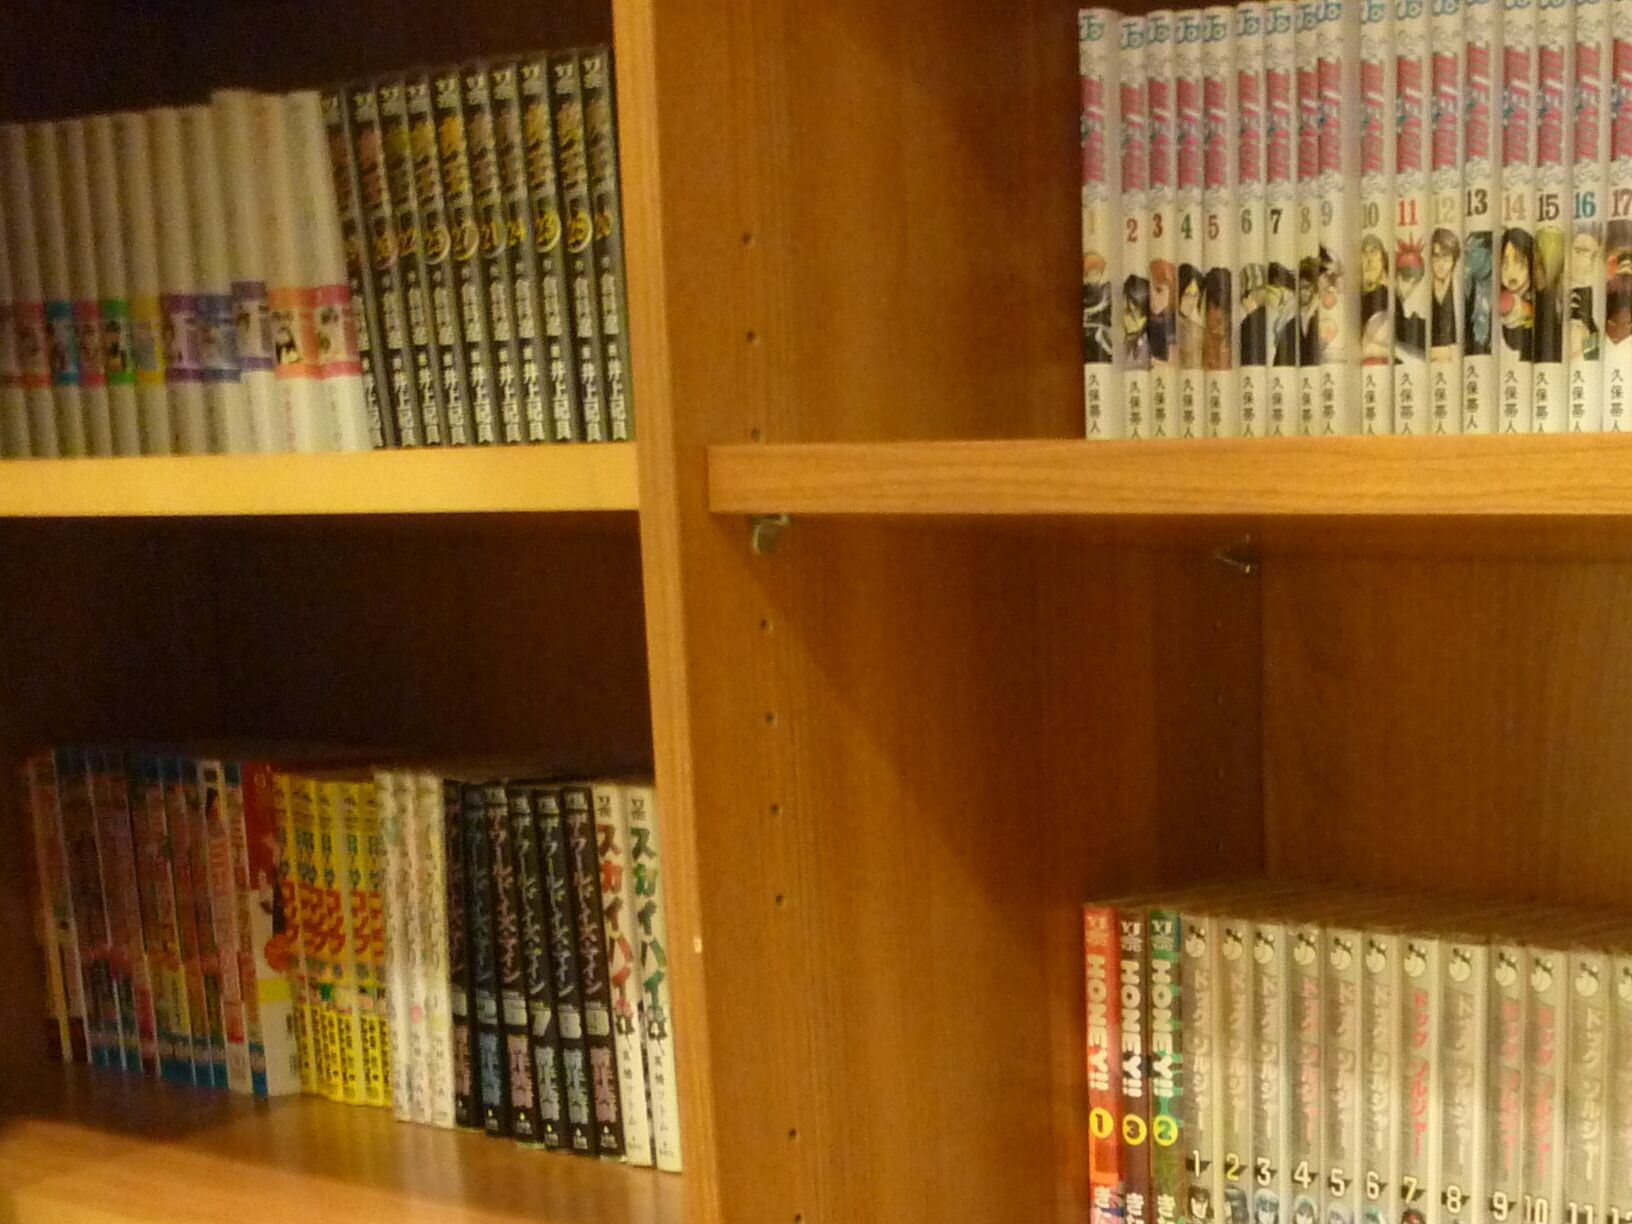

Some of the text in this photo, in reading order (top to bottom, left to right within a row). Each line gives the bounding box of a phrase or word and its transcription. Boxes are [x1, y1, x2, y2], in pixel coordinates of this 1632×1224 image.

[1397, 197, 1419, 226] 11
[1466, 189, 1489, 216] 13
[1573, 191, 1596, 219] 16
[1126, 219, 1138, 242] 2
[1152, 214, 1164, 238] 3
[1180, 214, 1193, 239] 4
[1269, 209, 1282, 234] 7
[1193, 1150, 1200, 1177] 1
[1257, 1156, 1271, 1187] 3
[1294, 1158, 1310, 1189] 4
[1367, 1171, 1379, 1200] 6
[1403, 1176, 1418, 1203] 7
[1446, 1185, 1461, 1213] 8
[1493, 1192, 1508, 1222] 9
